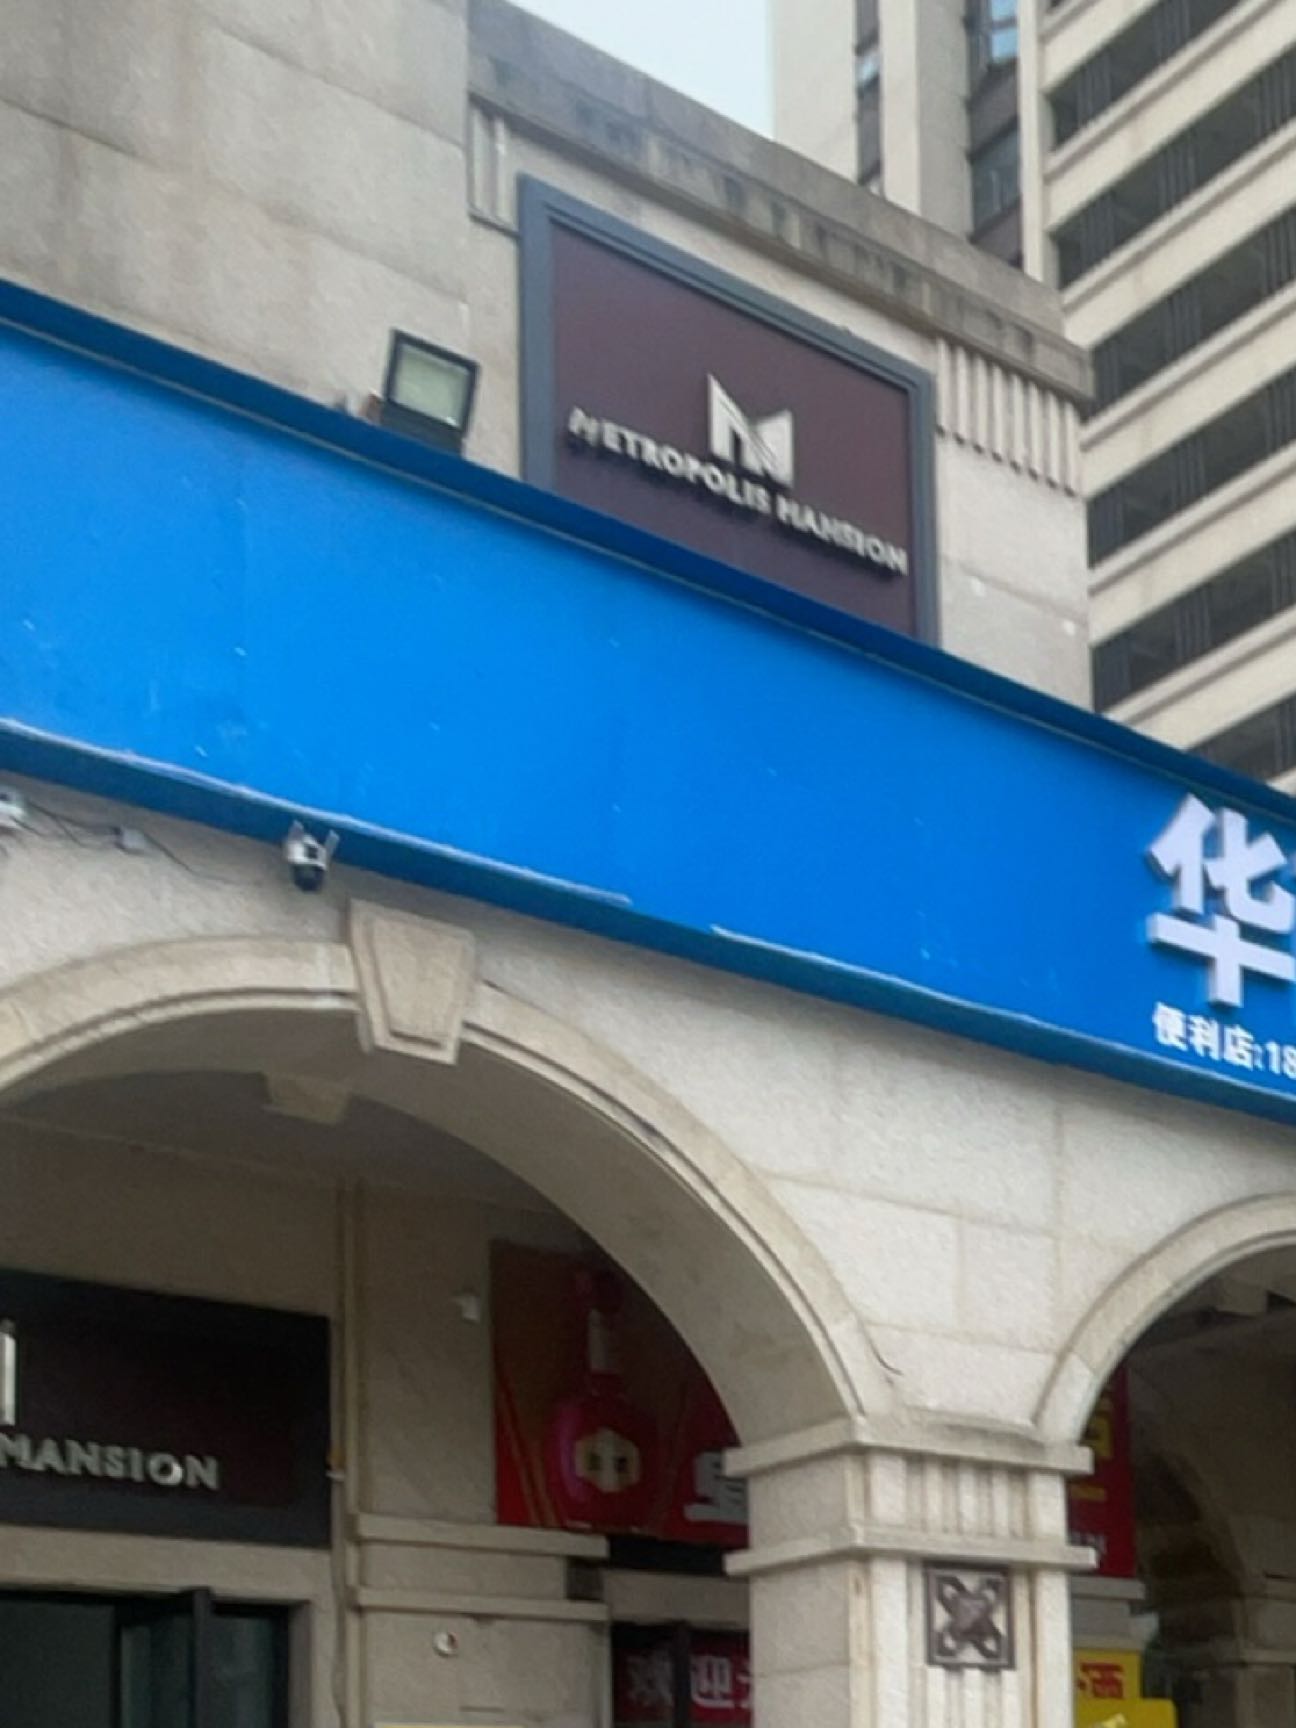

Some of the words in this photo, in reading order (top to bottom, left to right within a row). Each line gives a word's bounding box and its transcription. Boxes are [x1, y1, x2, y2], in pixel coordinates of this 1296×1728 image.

[568, 406, 771, 514] METROPOLIS
[776, 494, 908, 576] MANSION
[0, 1433, 221, 1491] MANSION
